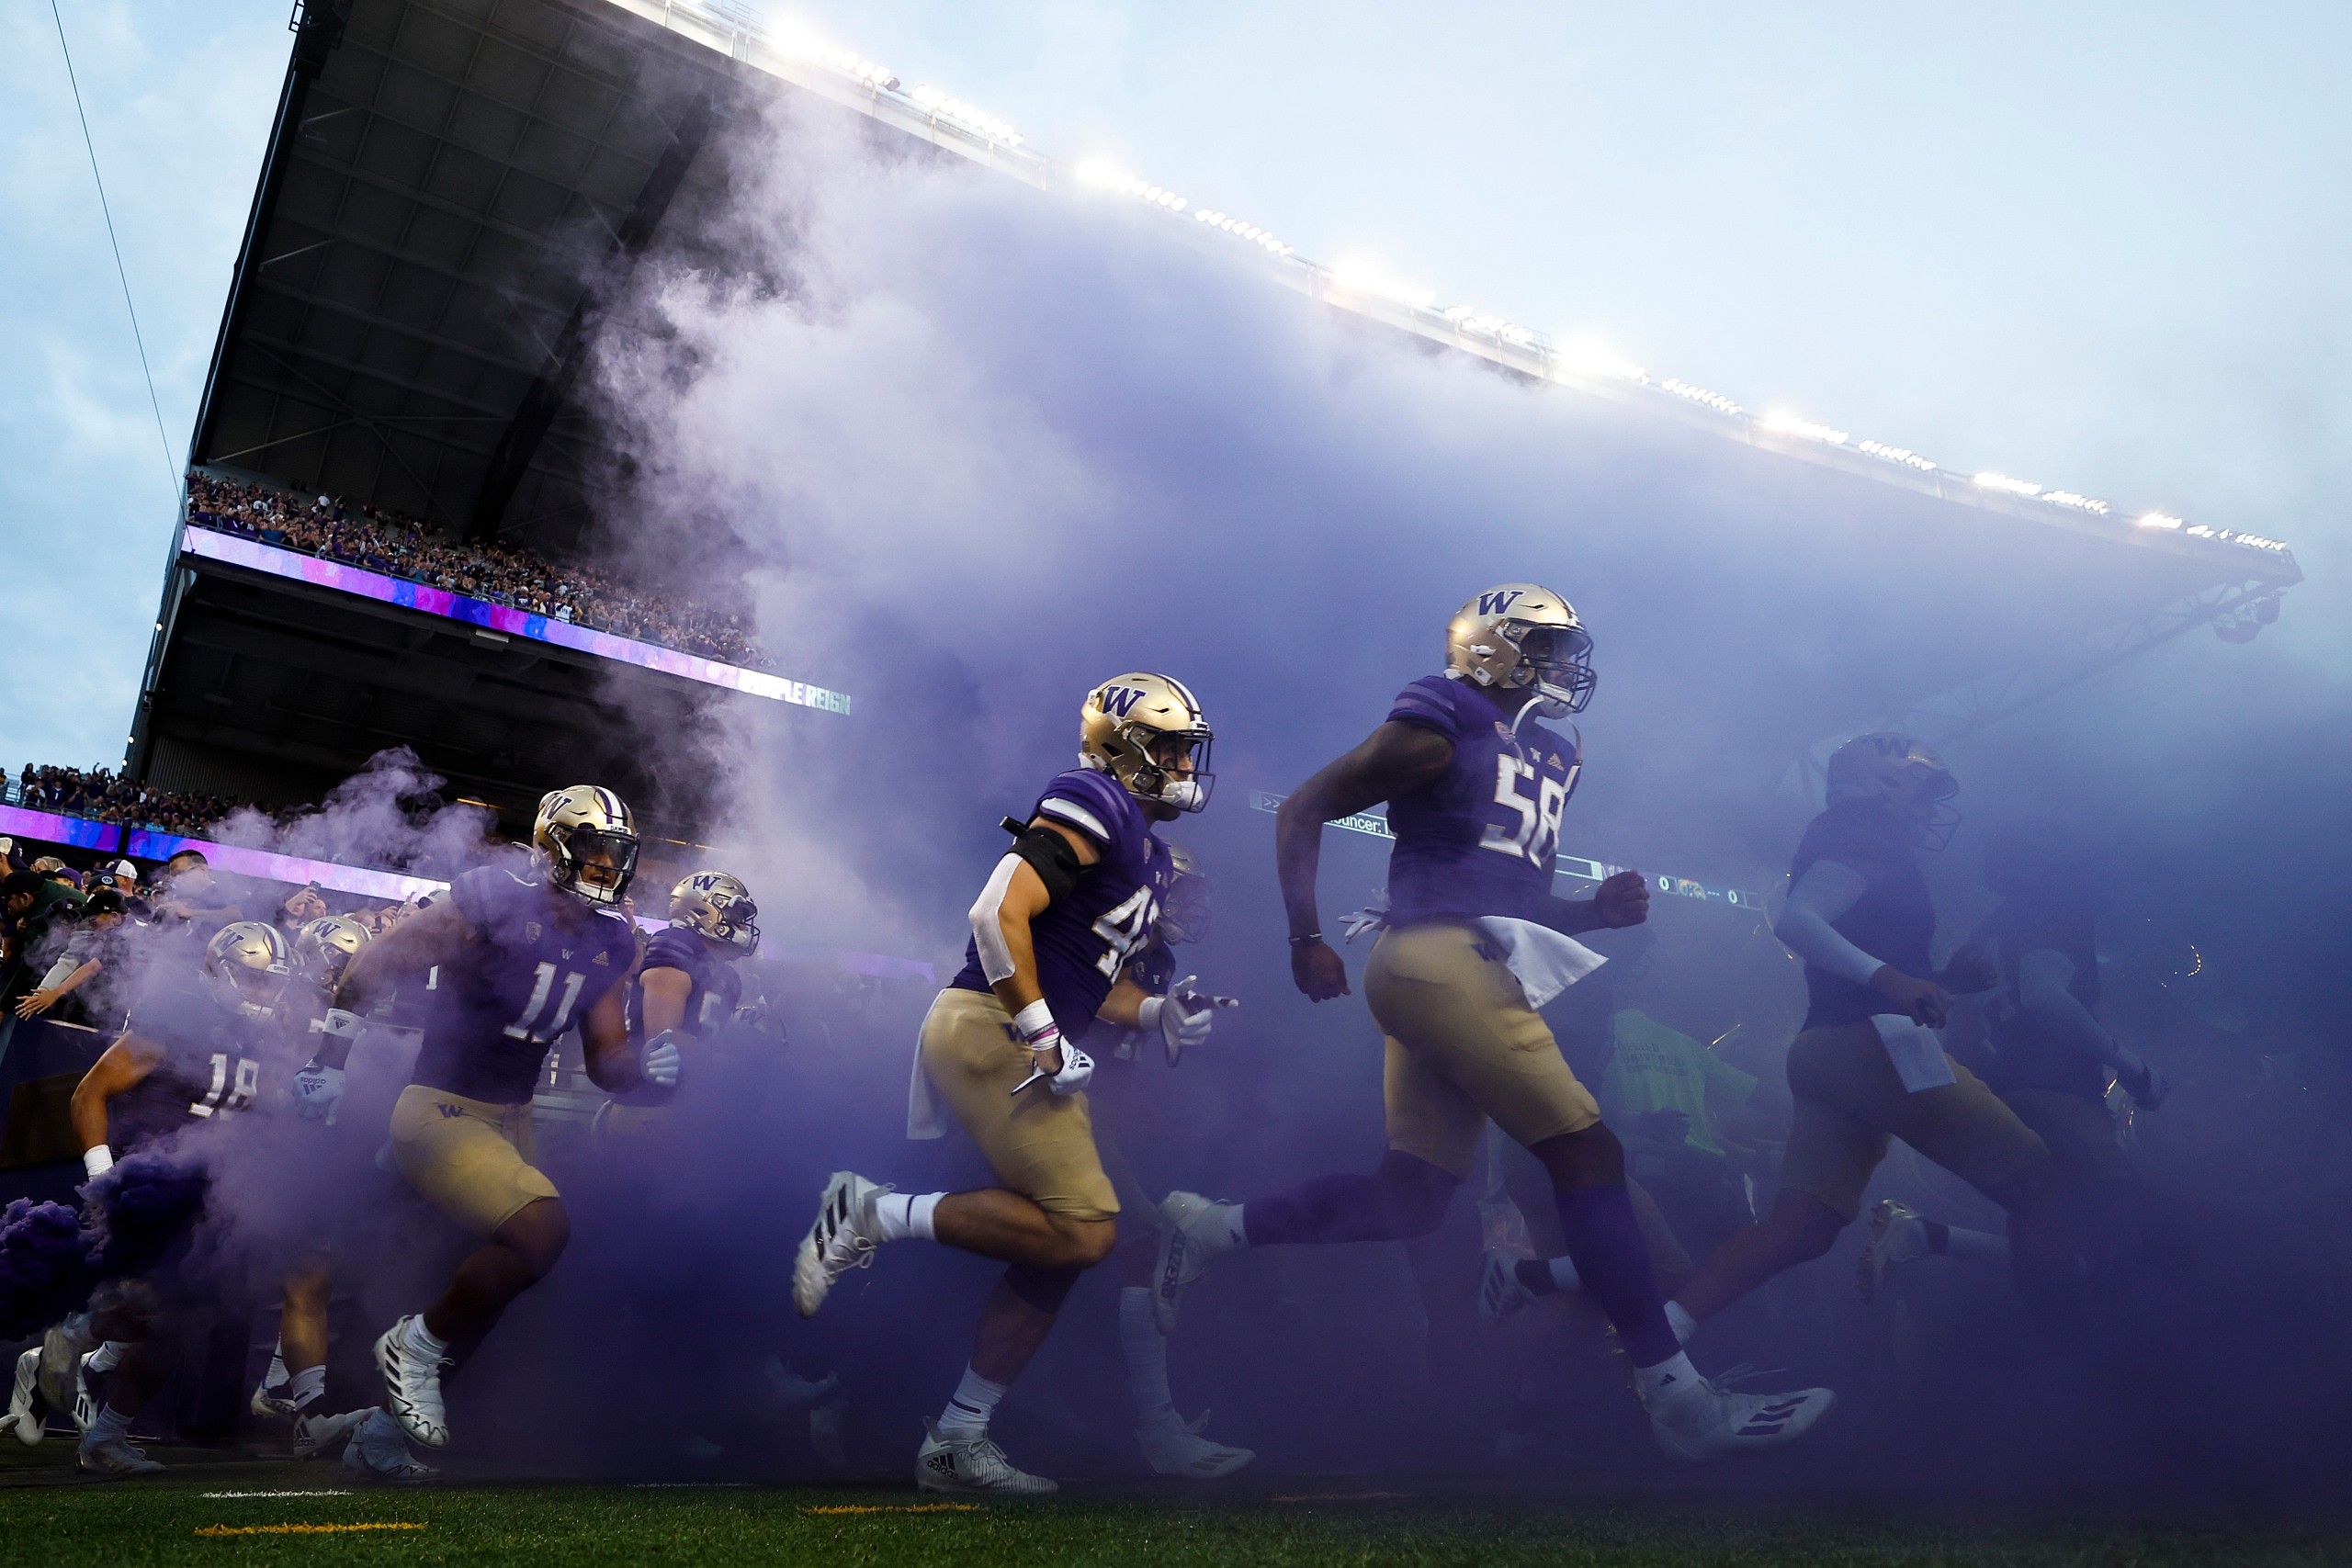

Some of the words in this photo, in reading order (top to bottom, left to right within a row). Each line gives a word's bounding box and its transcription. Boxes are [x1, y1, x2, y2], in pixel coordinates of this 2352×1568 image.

[1477, 591, 1524, 616] W
[806, 683, 851, 716] REIGN
[1102, 686, 1147, 718] W
[1873, 738, 1914, 759] W
[540, 795, 573, 820] W
[1478, 753, 1566, 870] 58
[1330, 816, 1382, 834] ouncer:
[692, 875, 722, 892] W
[1658, 876, 1669, 891] 0
[1727, 890, 1738, 905] 0
[214, 928, 245, 953] W
[311, 920, 342, 939] W
[561, 948, 574, 960] W
[503, 961, 587, 1043] 11
[188, 1053, 260, 1120] 18
[300, 1077, 327, 1085] adidas
[437, 1104, 464, 1118] W
[927, 1460, 959, 1479] adidas
